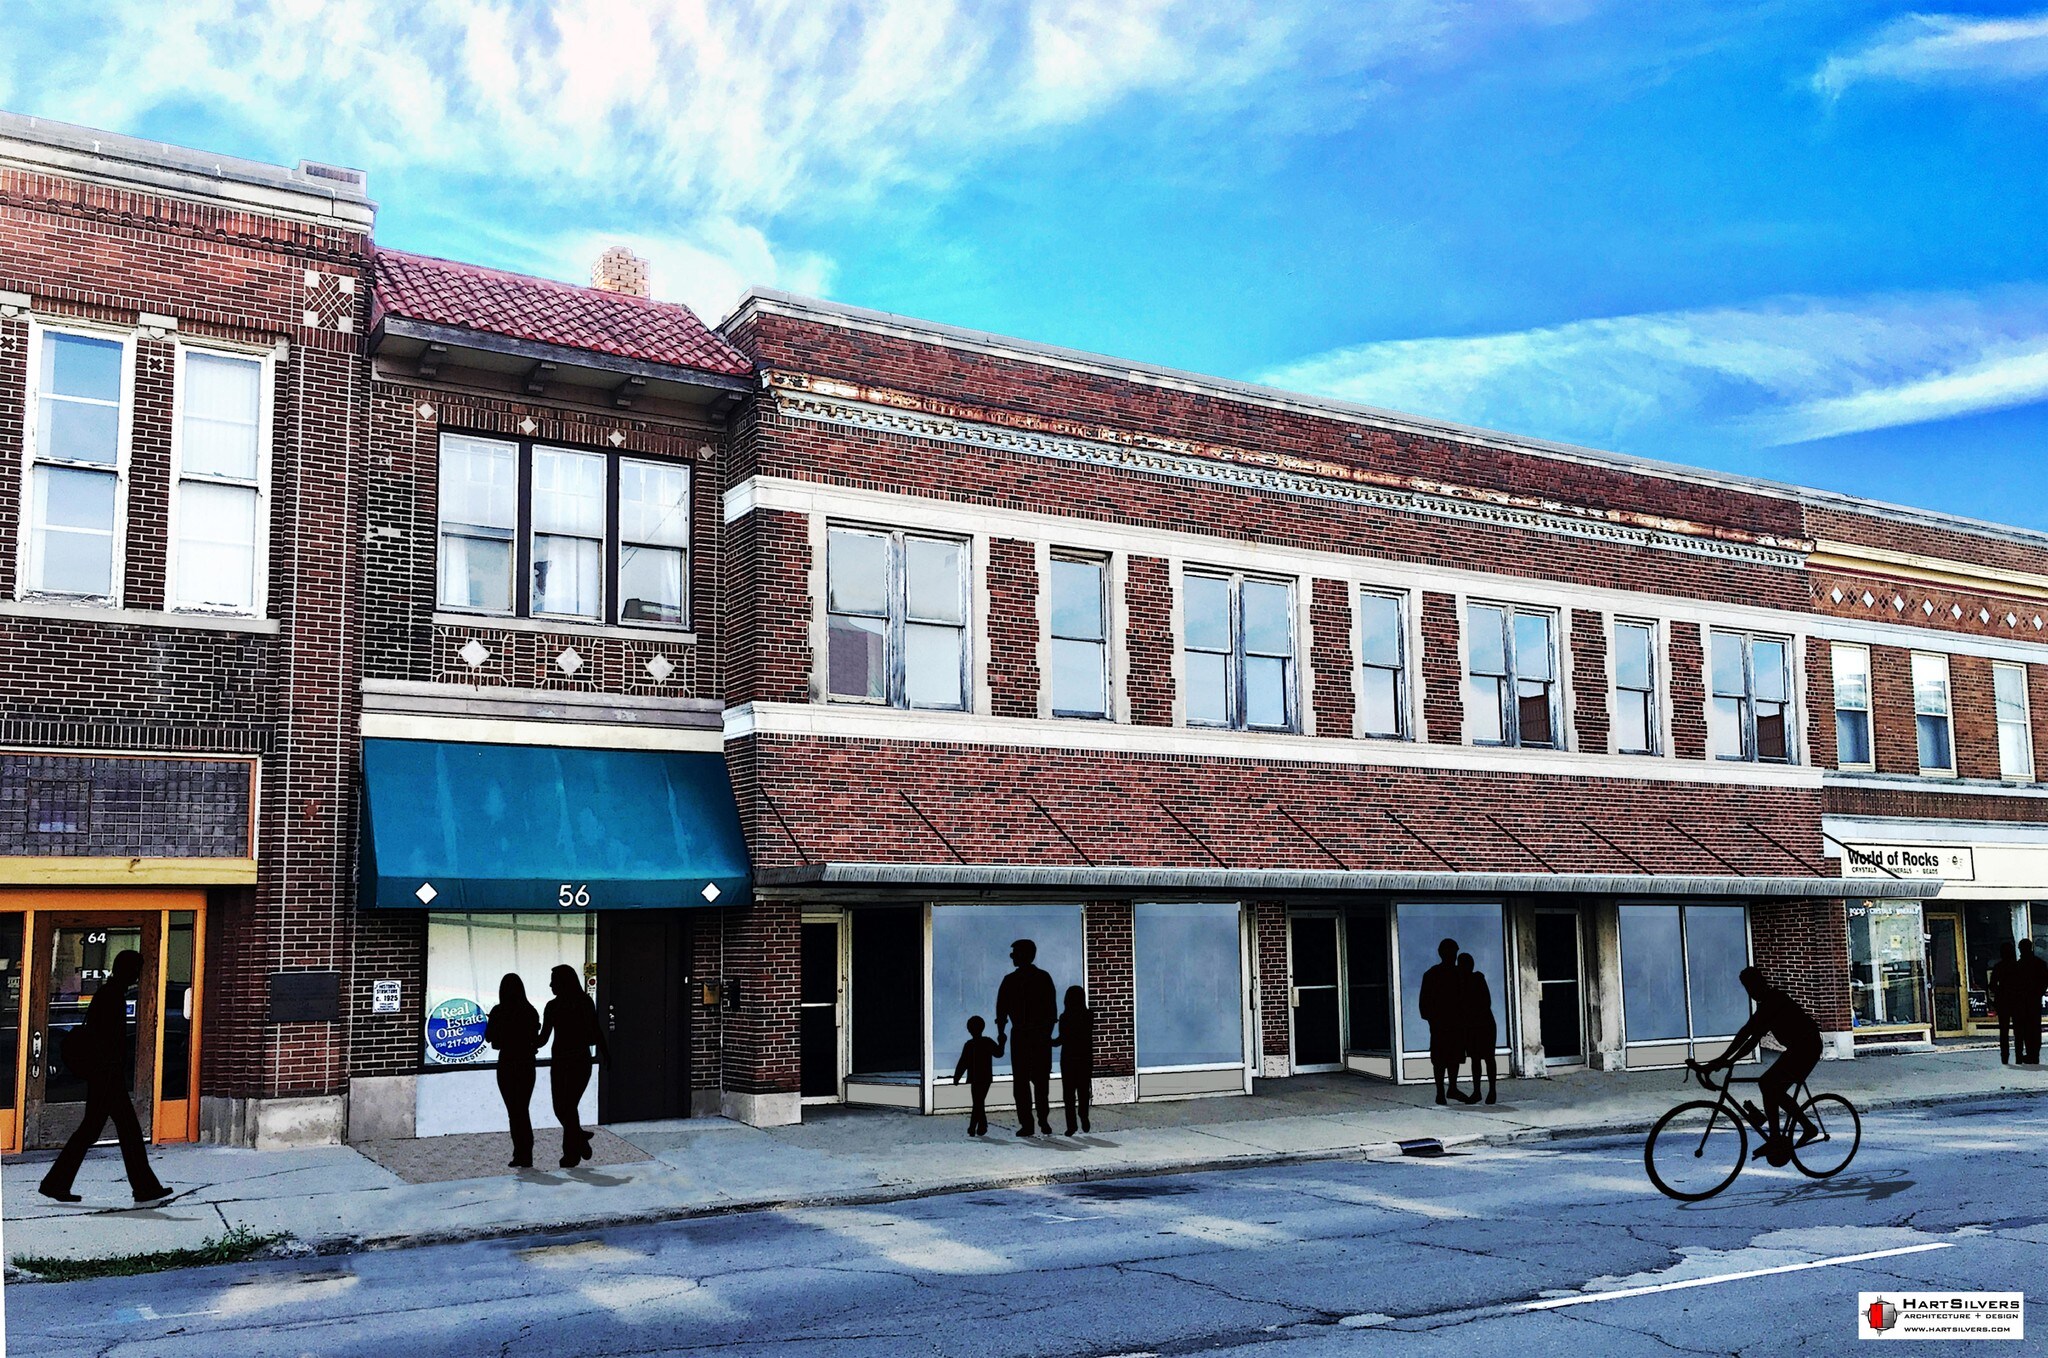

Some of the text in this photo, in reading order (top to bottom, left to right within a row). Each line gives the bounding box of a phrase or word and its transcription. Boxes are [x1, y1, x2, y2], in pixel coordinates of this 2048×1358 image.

[1847, 850, 1939, 867] World of Rocks
[558, 884, 590, 907] 56
[87, 932, 106, 944] 64
[81, 969, 113, 979] FLY
[440, 1002, 470, 1019] Real
[446, 1013, 484, 1030] Estate
[436, 1026, 464, 1040] One
[447, 1034, 483, 1049] 217-3000
